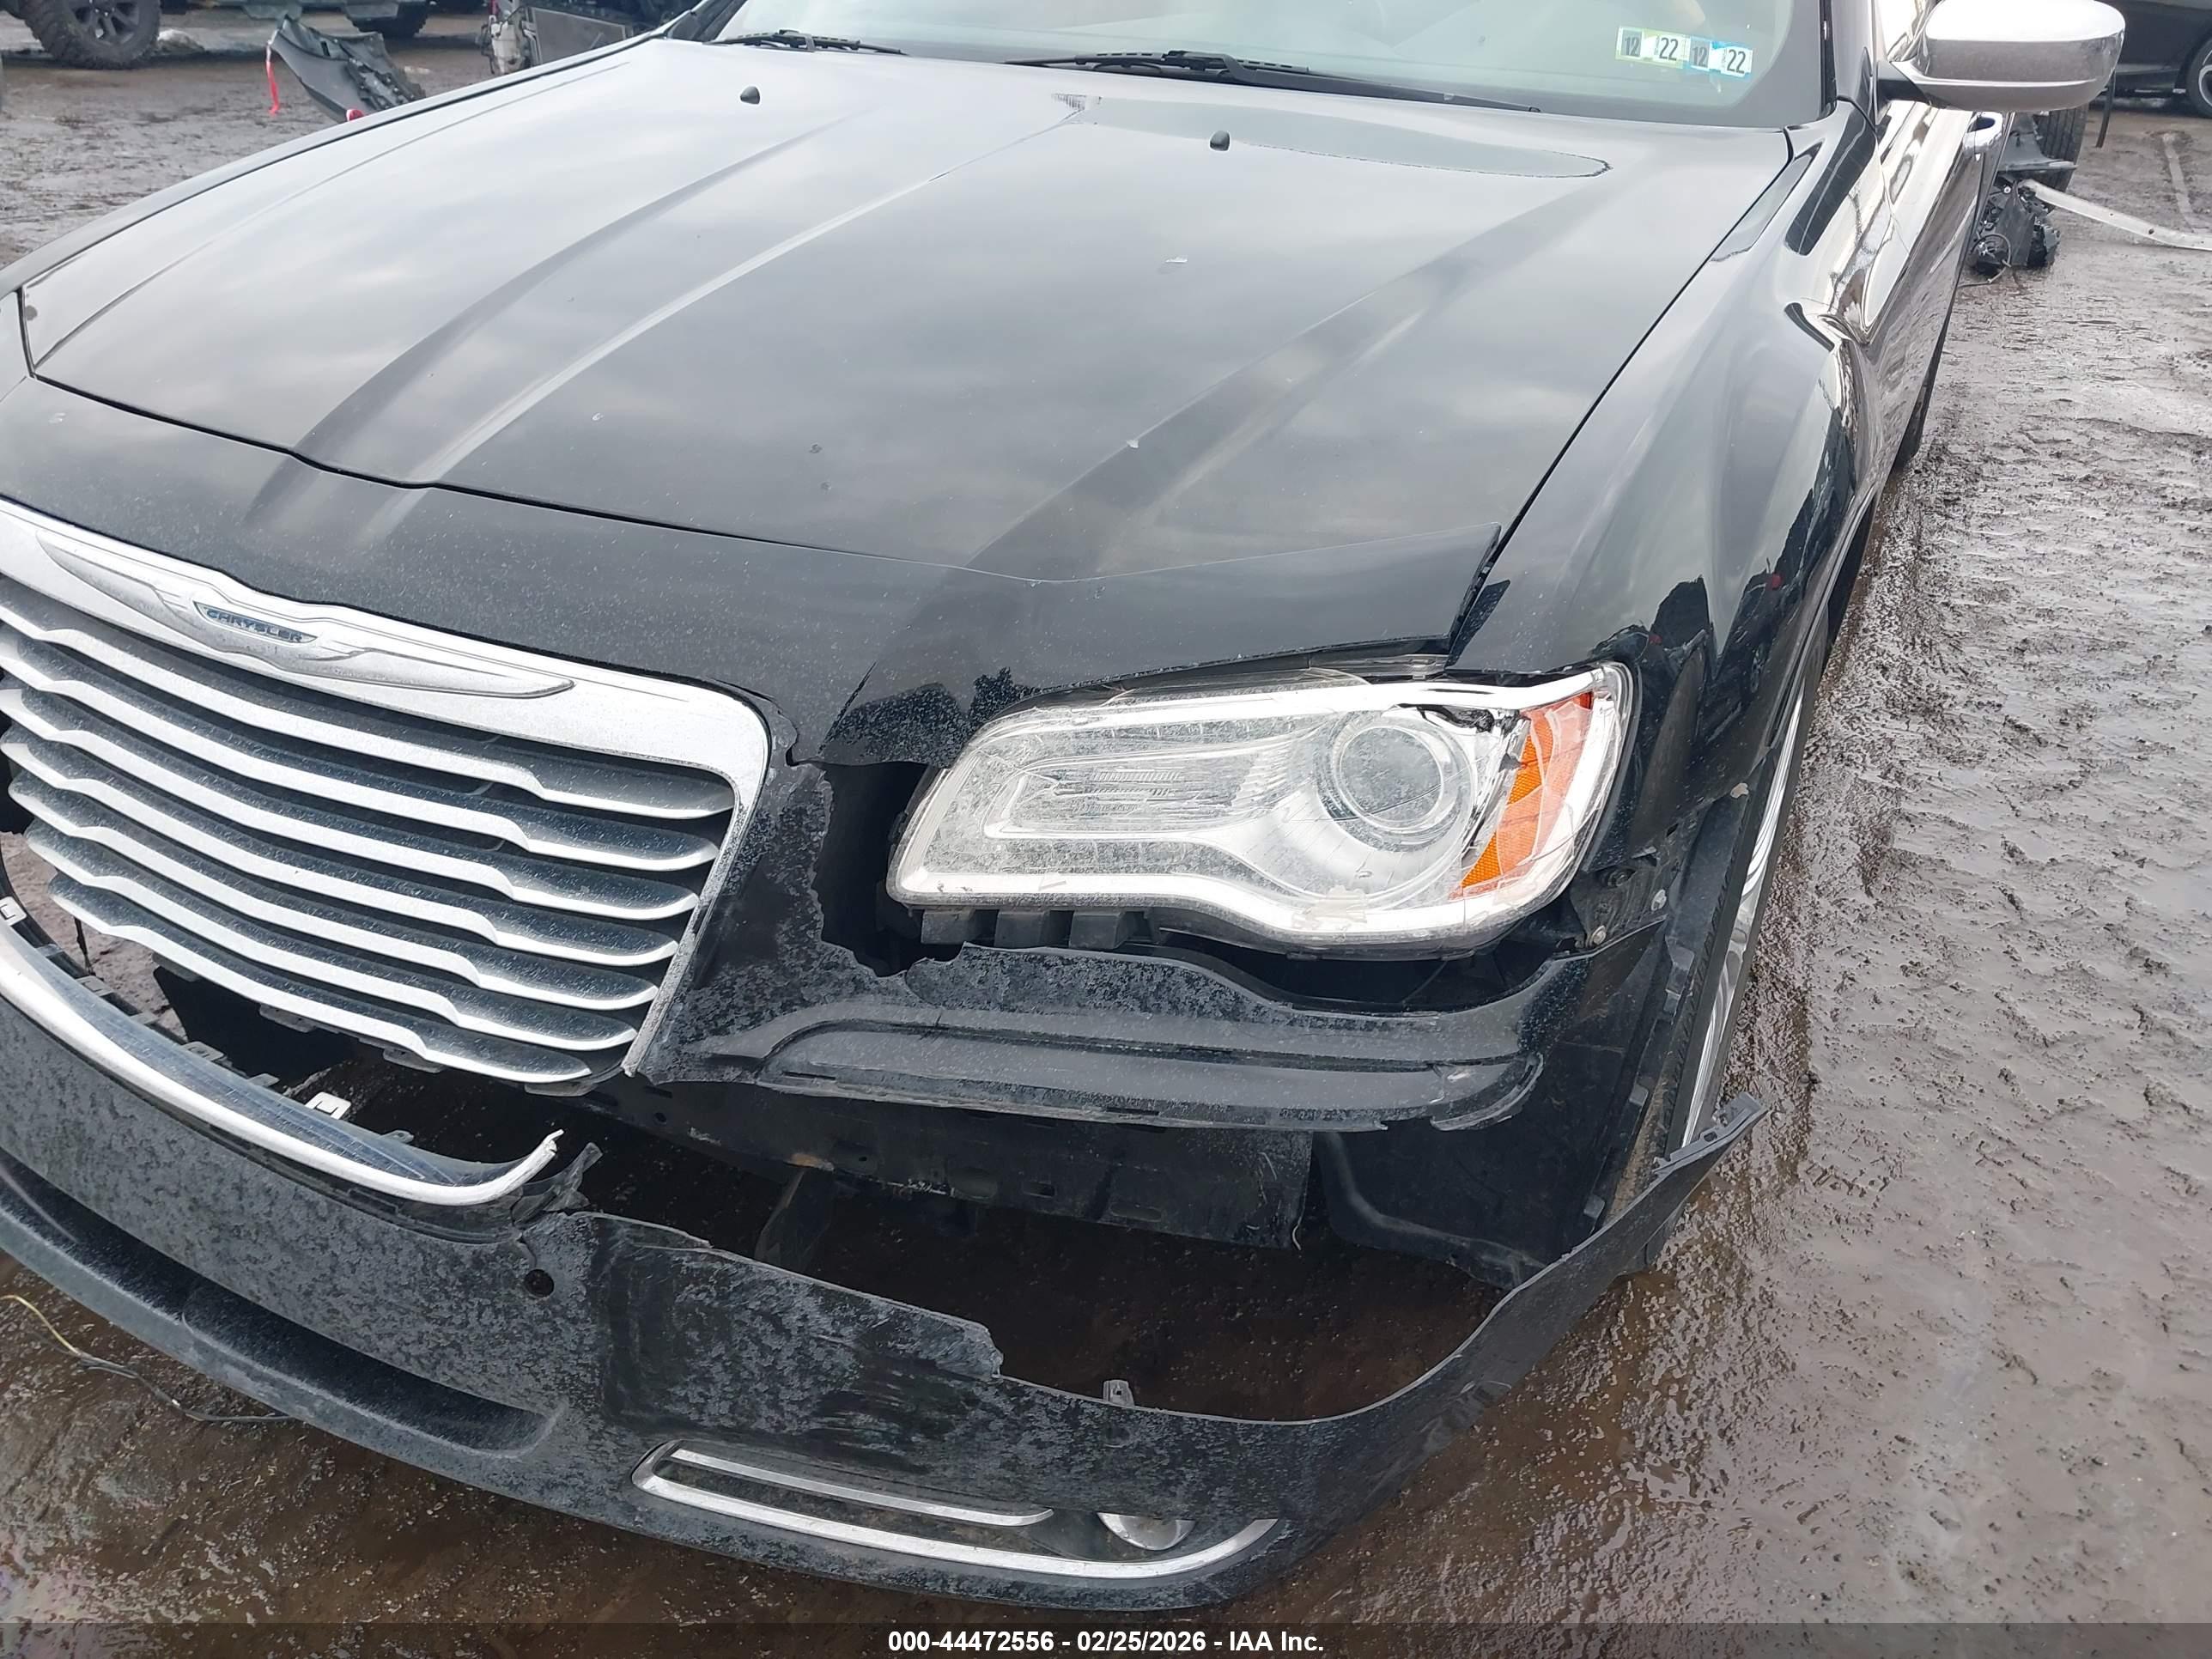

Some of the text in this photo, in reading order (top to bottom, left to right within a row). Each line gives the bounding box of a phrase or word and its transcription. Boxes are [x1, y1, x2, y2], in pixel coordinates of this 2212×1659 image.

[1624, 37, 1639, 58] 12
[1659, 37, 1679, 61] 22
[1692, 46, 1708, 68] 12
[1726, 49, 1747, 74] 22
[206, 608, 302, 643] CHRYSLER
